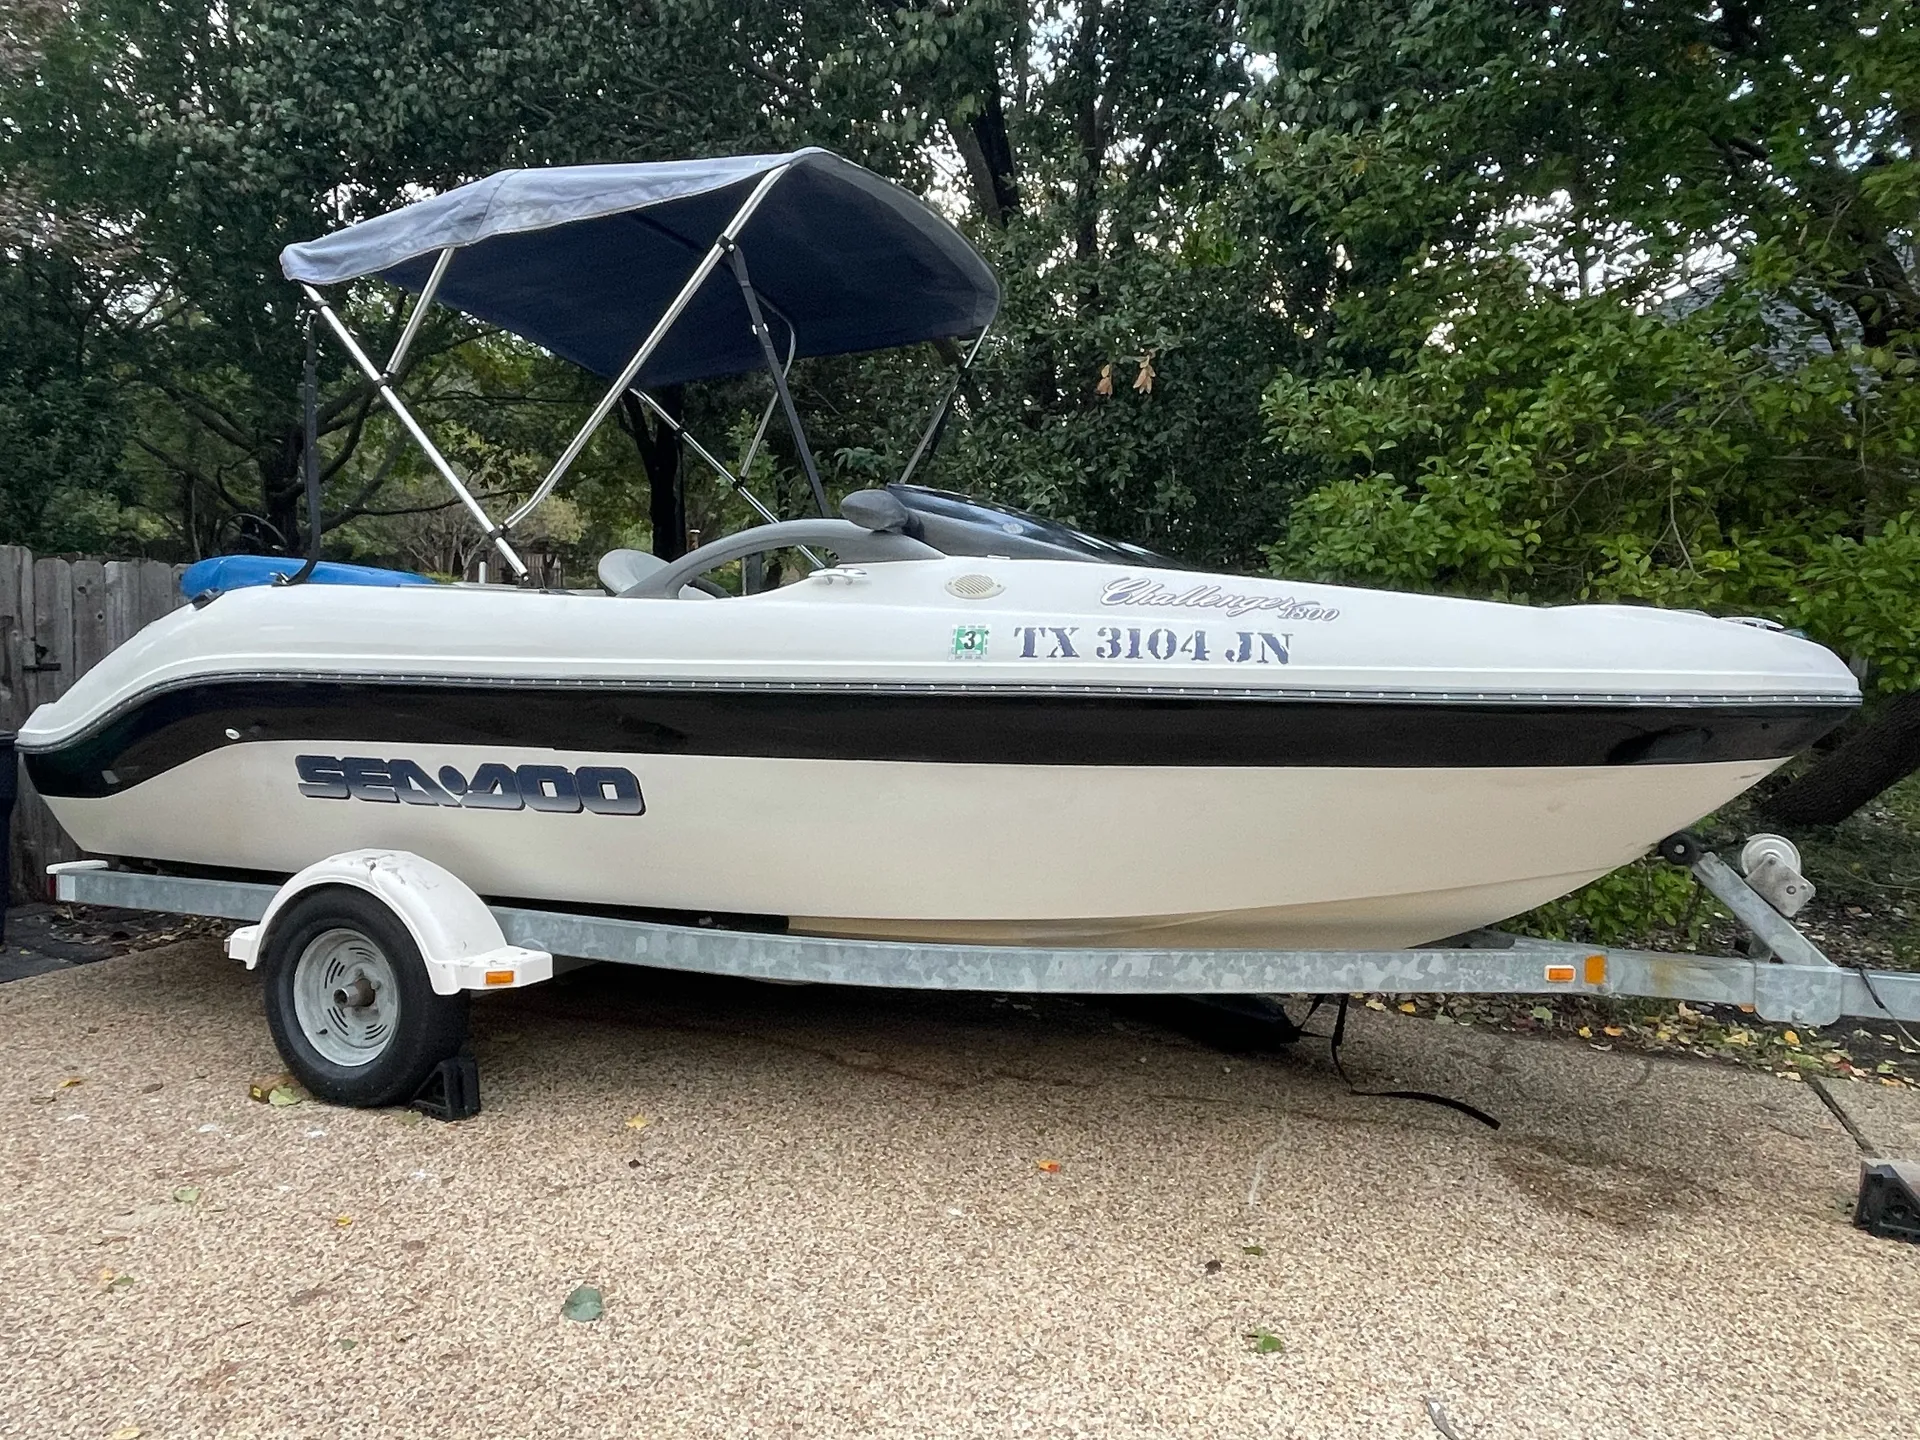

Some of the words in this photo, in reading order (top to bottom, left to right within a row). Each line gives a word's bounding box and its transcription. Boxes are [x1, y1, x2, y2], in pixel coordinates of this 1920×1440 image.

[1100, 577, 1296, 617] Challenger
[1277, 601, 1340, 621] 1800
[963, 630, 977, 650] 3
[1014, 627, 1080, 659] TX
[1096, 627, 1210, 662] 3104
[1225, 632, 1294, 665] JN
